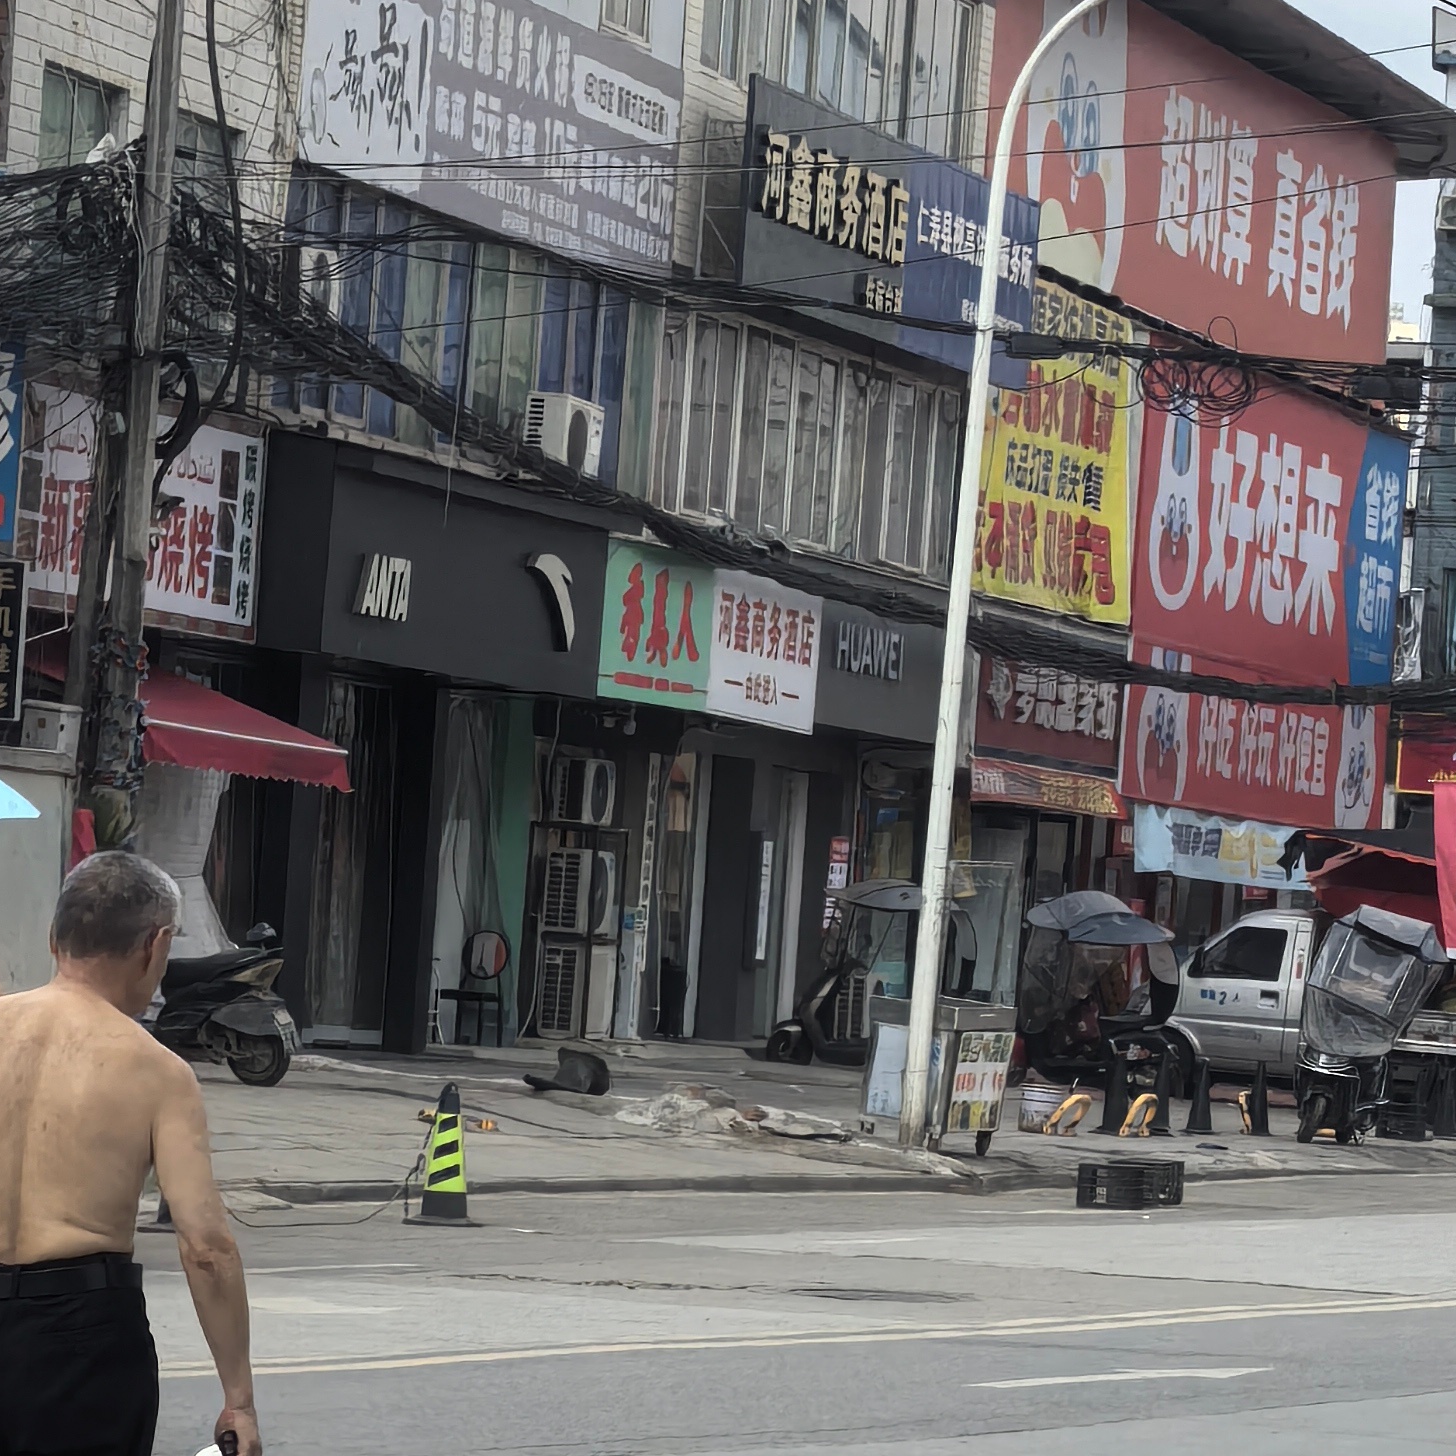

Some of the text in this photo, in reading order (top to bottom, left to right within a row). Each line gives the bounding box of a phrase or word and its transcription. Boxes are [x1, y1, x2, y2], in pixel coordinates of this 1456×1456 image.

[761, 125, 911, 268] 河鑫商务酒店
[1155, 85, 1259, 286] 超划算
[1267, 147, 1360, 335] 真省钱
[1203, 414, 1344, 638] 好想来
[361, 552, 413, 623] ANTA
[718, 588, 815, 668] 河鑫商务酒店
[838, 619, 906, 682] HUAWEI
[1196, 694, 1330, 797] 好吃 好玩 好便宜
